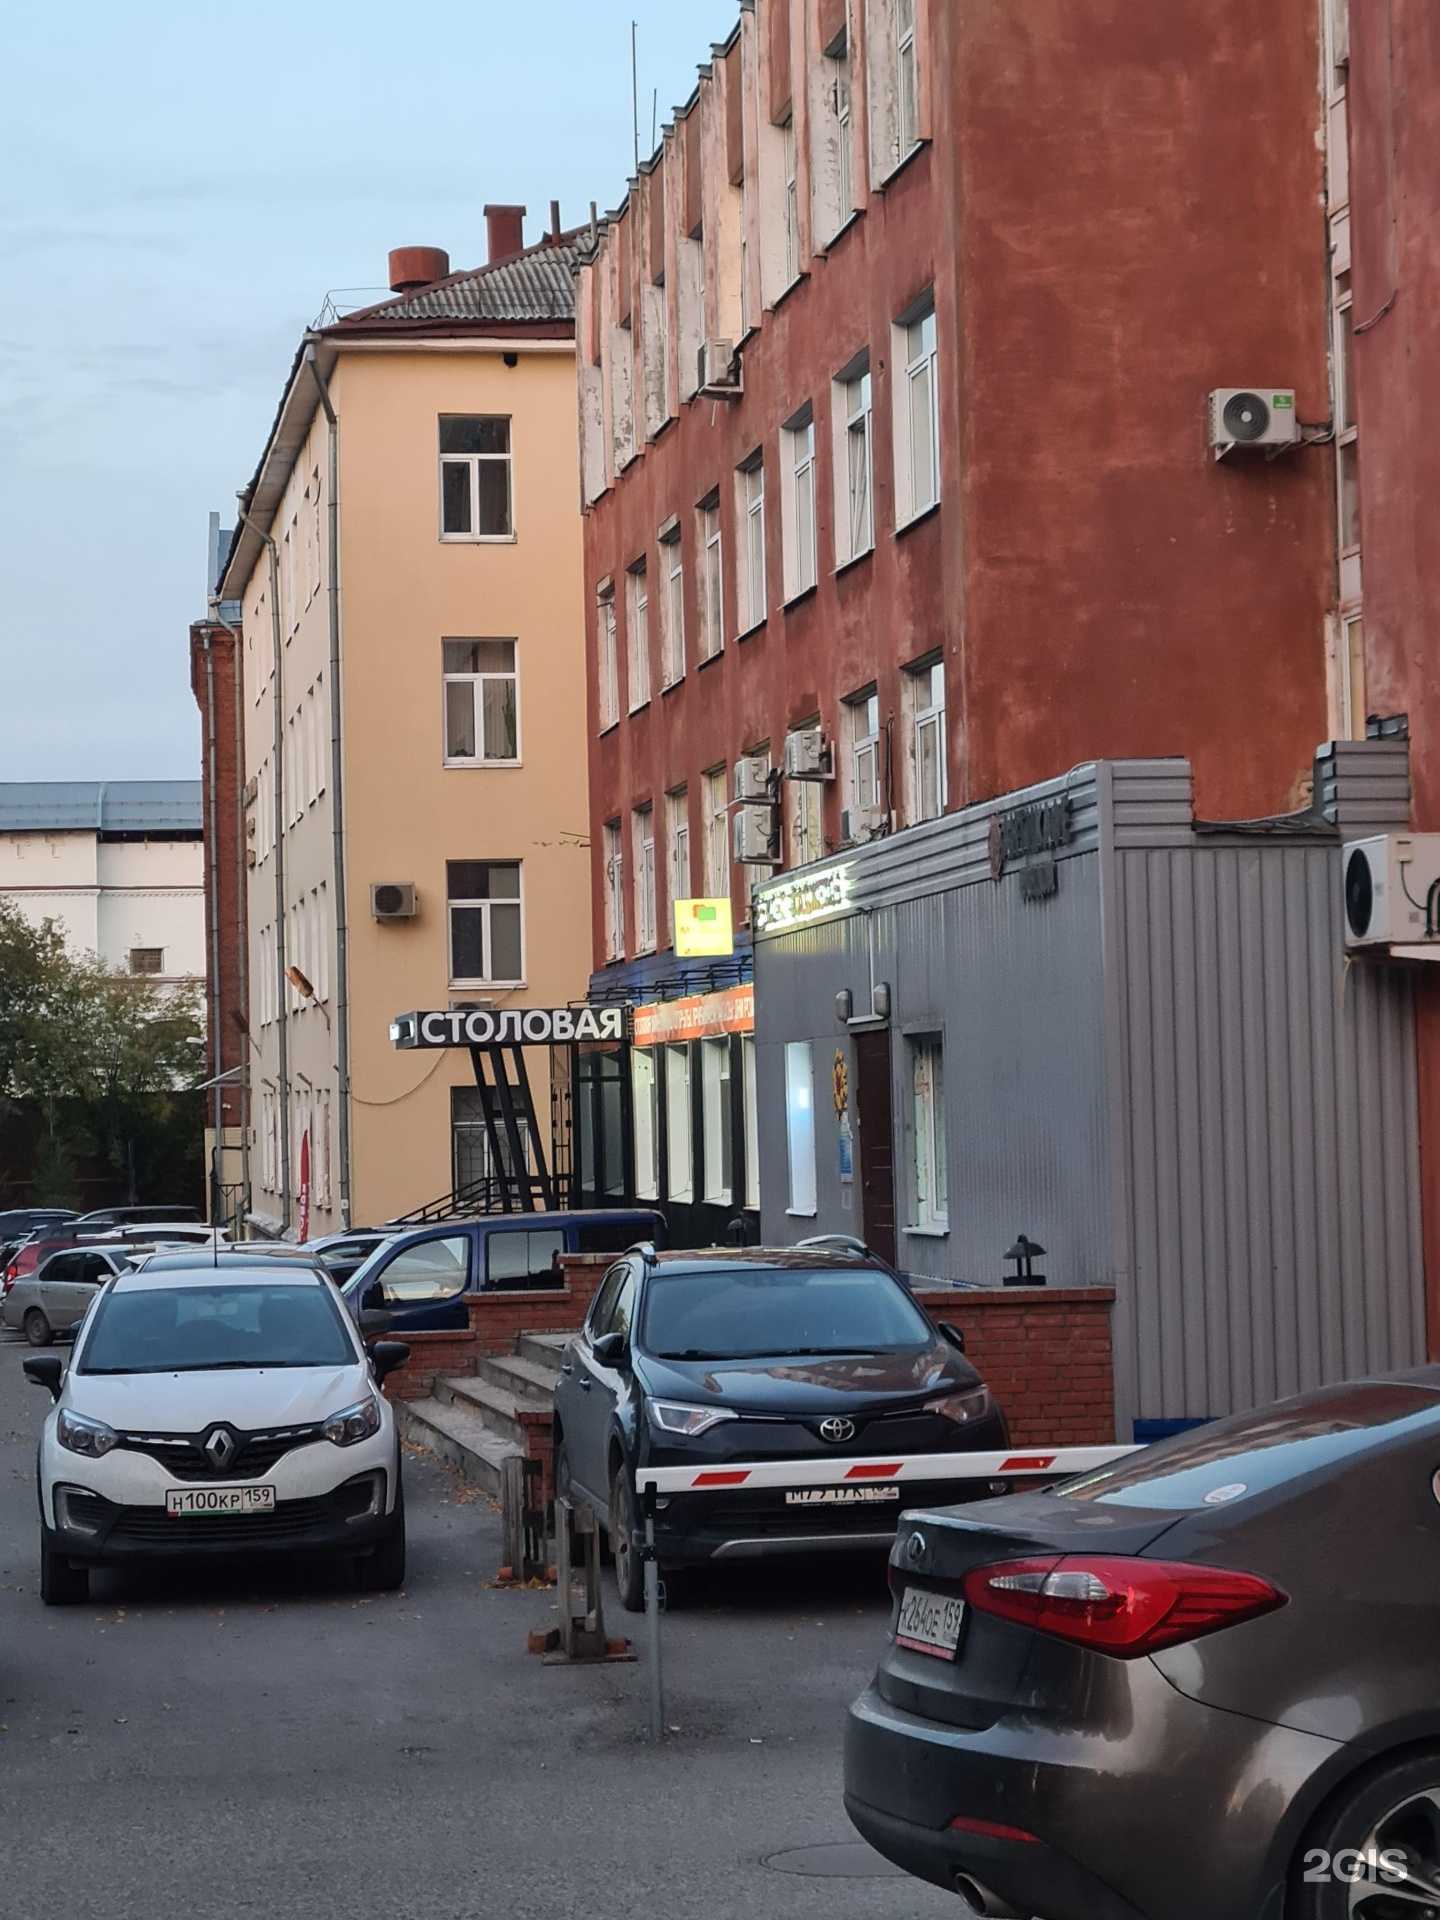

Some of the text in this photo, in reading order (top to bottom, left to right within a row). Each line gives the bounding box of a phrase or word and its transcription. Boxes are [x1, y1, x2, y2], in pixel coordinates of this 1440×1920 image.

[421, 1008, 622, 1043] СТОЛОВАЯ
[172, 1489, 270, 1510] Н100КР 159
